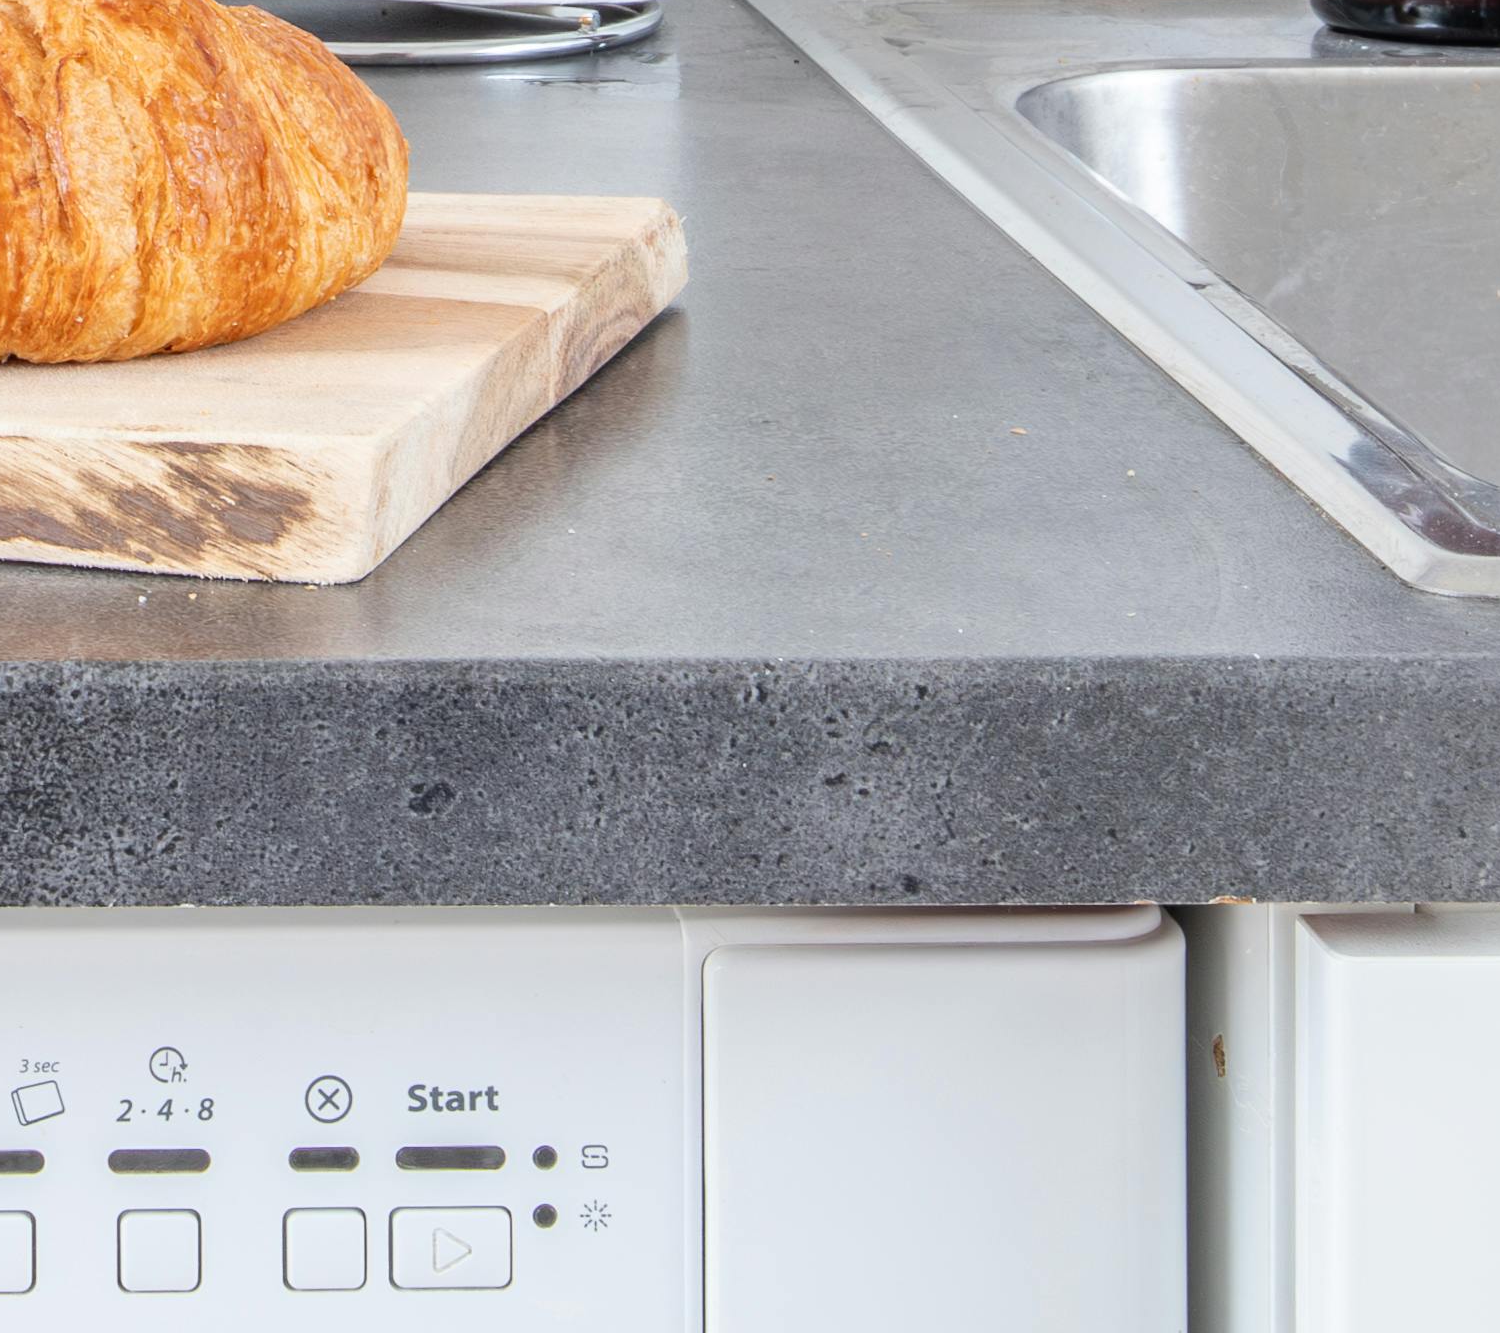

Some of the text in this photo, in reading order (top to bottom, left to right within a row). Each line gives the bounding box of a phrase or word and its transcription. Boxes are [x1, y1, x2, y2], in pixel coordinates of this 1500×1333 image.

[19, 1058, 60, 1074] 3 sec
[407, 1083, 499, 1113] Start
